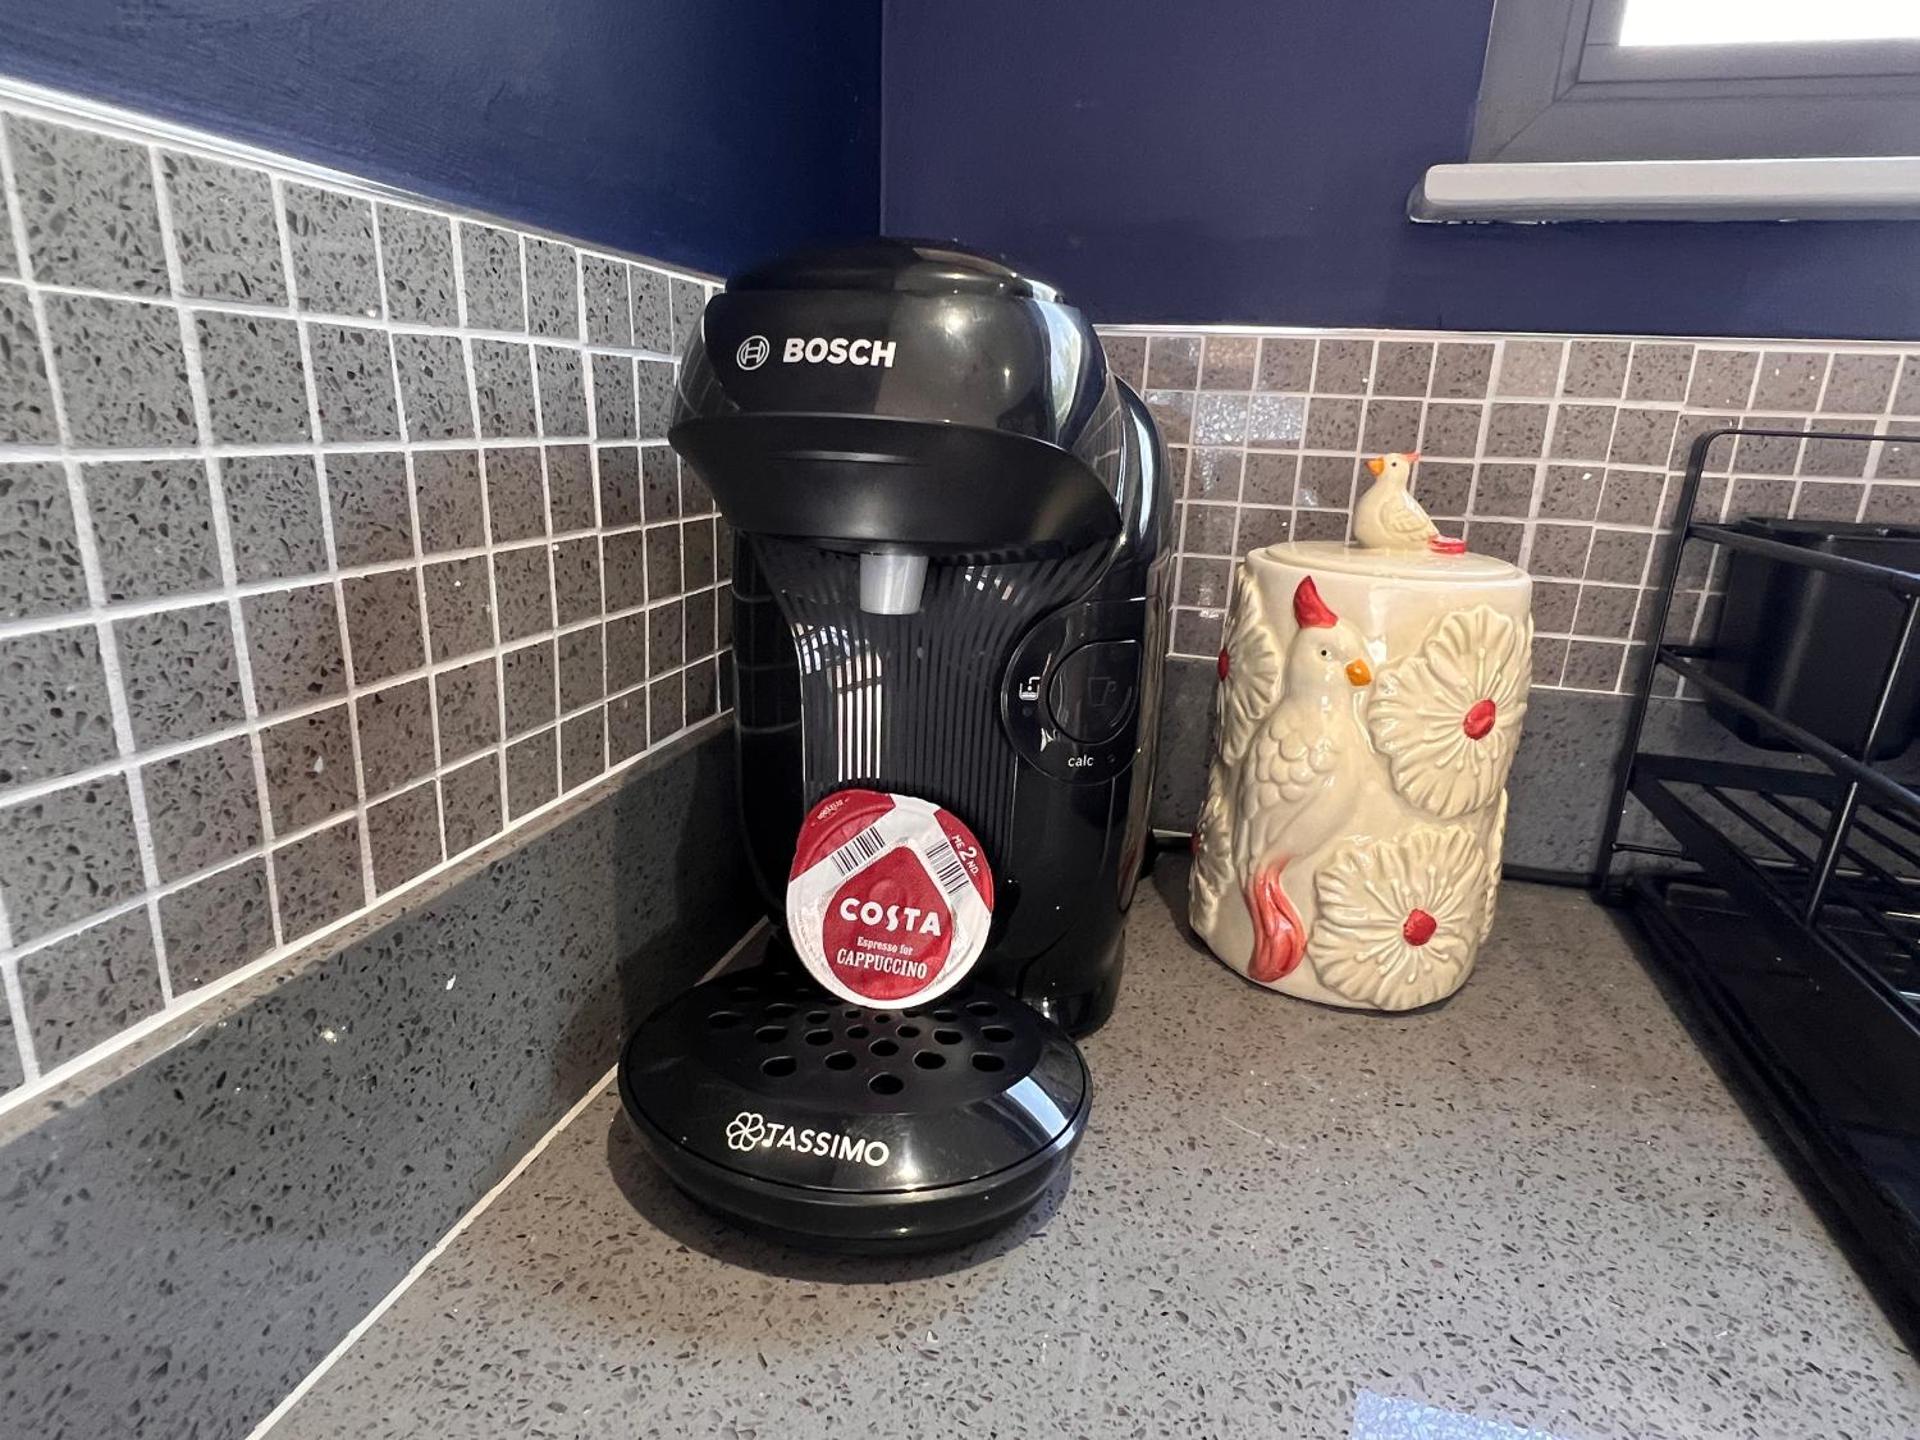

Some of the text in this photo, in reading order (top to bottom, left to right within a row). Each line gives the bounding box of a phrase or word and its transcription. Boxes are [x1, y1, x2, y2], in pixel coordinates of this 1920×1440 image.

[783, 337, 897, 368] BOSCH
[1067, 754, 1094, 767] calc
[840, 897, 941, 937] COSTA
[857, 936, 914, 956] Espresso for
[836, 947, 928, 980] CAPPUCCINO
[761, 1122, 889, 1167] TASSIMO
